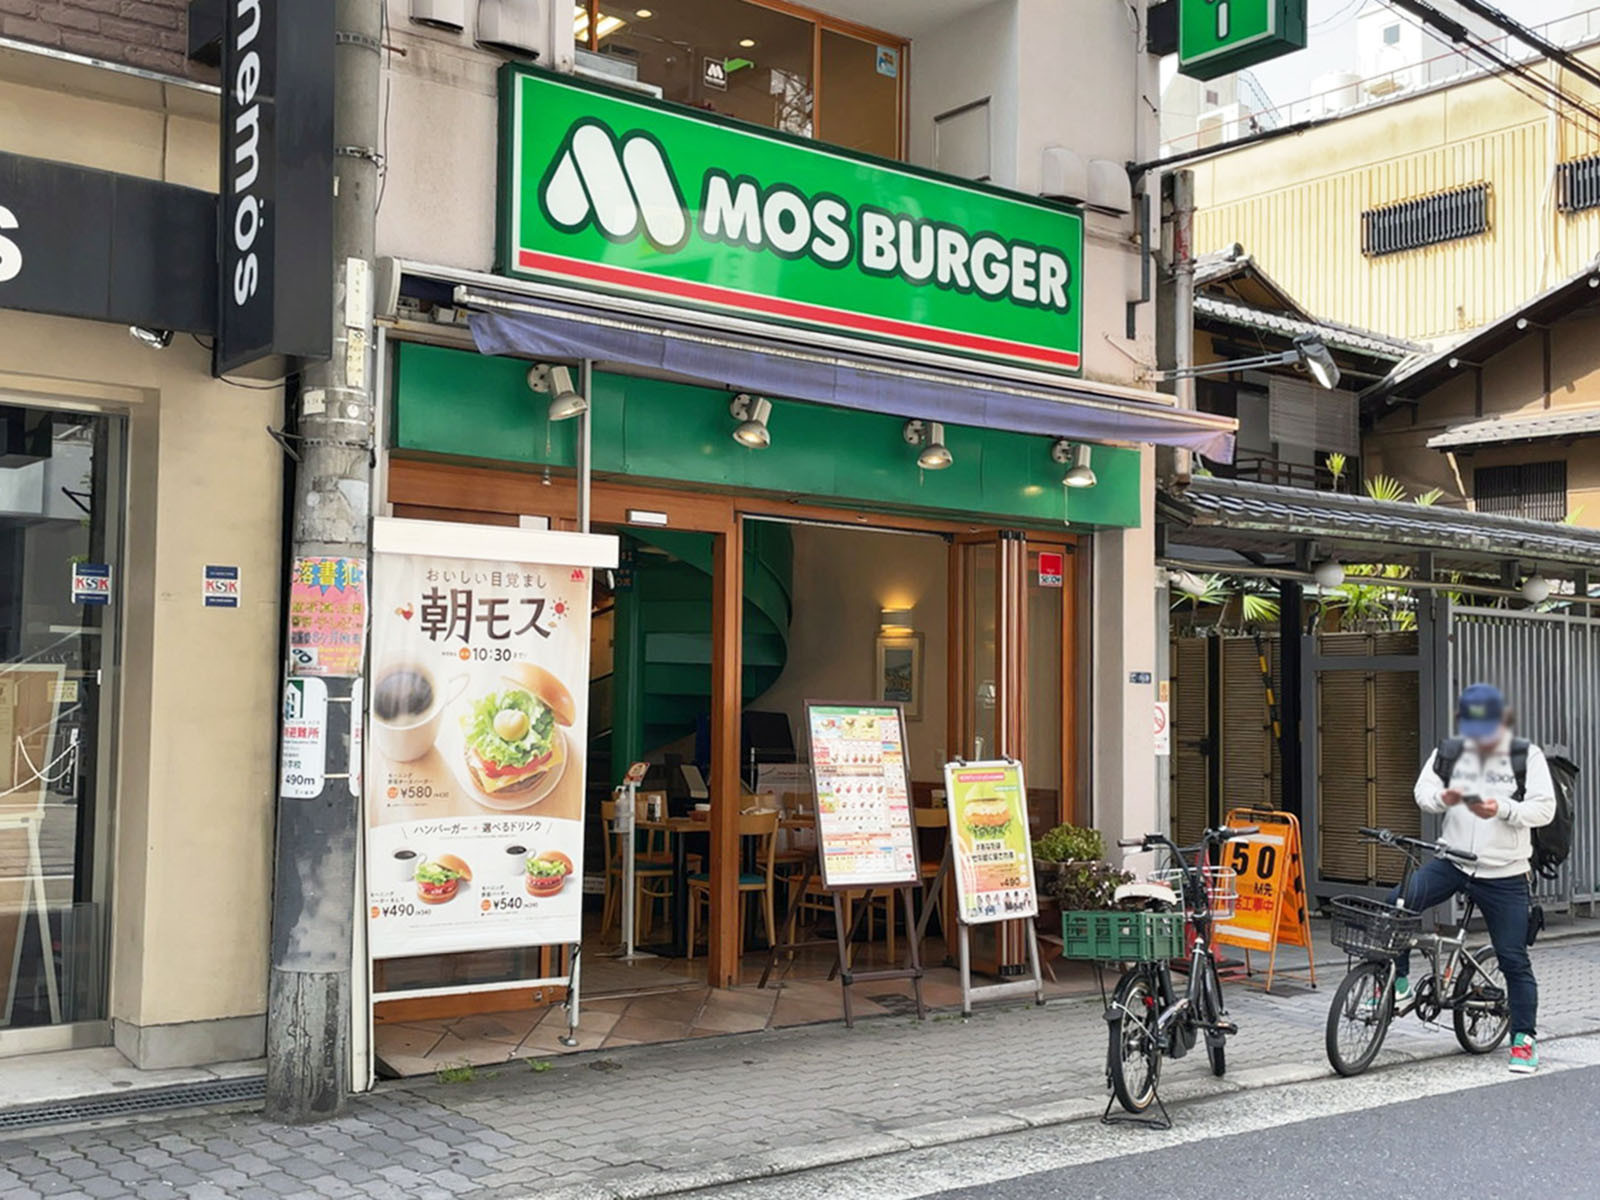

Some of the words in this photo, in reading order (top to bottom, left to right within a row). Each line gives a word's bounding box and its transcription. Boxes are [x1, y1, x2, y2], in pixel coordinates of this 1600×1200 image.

[702, 175, 850, 263] MOS
[862, 212, 1069, 308] BURGER
[75, 577, 109, 590] KSK
[426, 568, 547, 589] おいしい目覚まし
[205, 580, 237, 592] KSK
[421, 587, 551, 643] 朝モス
[473, 648, 511, 661] 10:30
[401, 786, 433, 798] ¥580
[413, 824, 468, 834] ハンバーガー
[482, 821, 542, 832] 選べるドリンク
[493, 896, 523, 909] ¥540
[382, 903, 415, 917] ¥490
